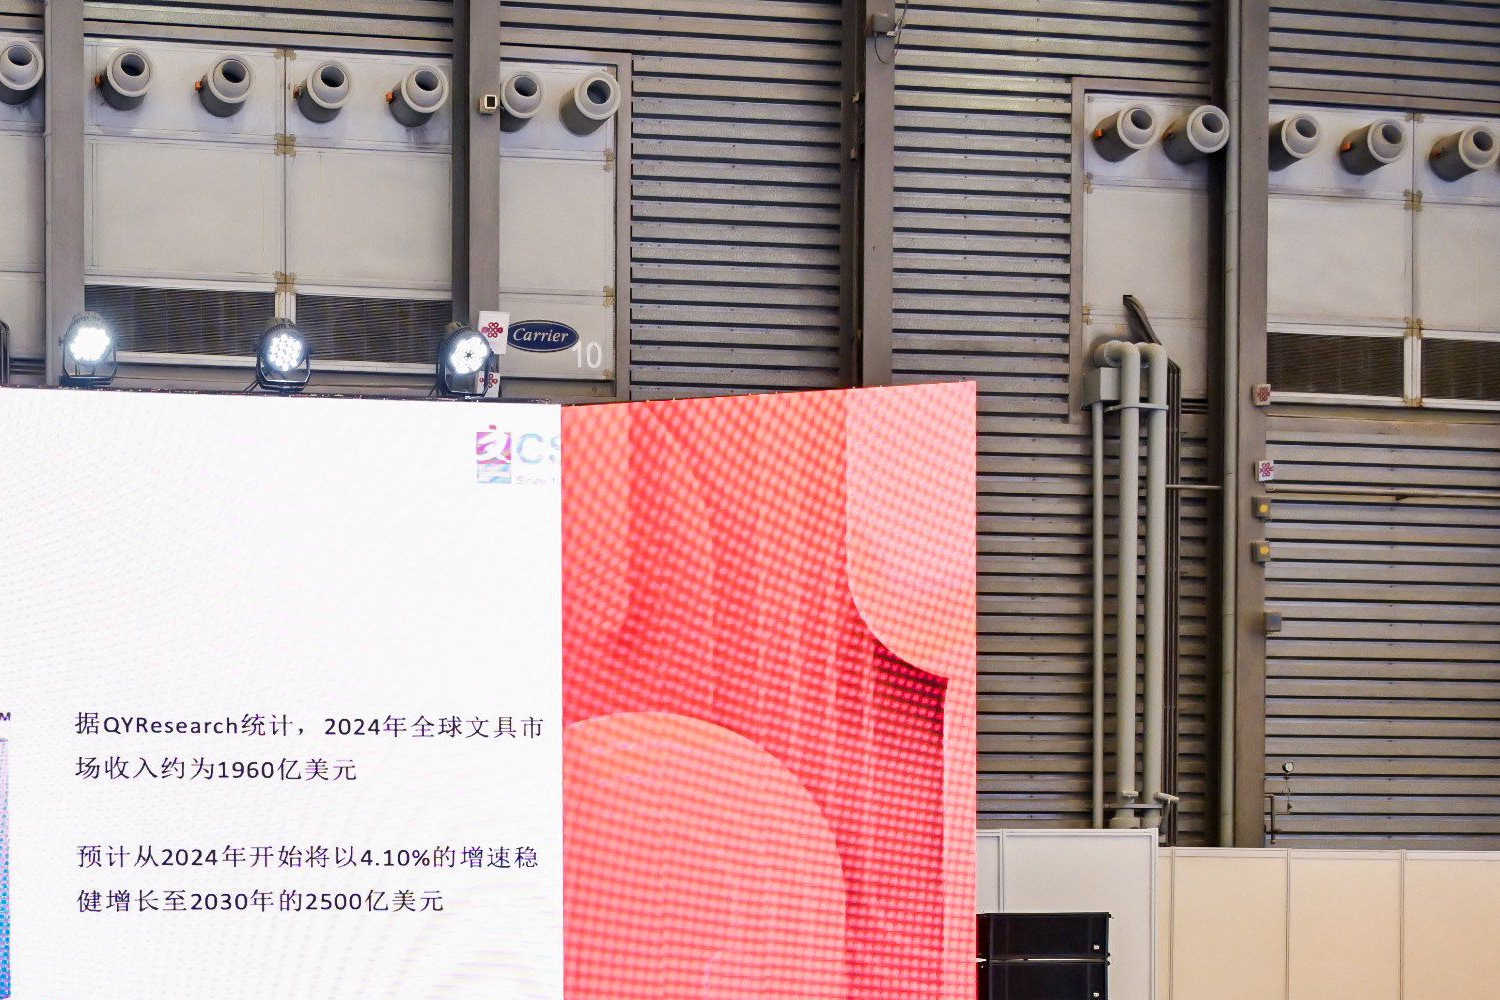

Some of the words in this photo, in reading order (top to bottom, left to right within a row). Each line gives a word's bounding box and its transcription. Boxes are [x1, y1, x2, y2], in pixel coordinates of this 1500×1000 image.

[512, 327, 570, 343] Carrier
[572, 341, 604, 369] 10
[74, 711, 545, 739] 据QYResearch统计，2024年全球文具市
[75, 756, 358, 781] 场收入约为1960亿美元
[76, 845, 538, 869] 预计从2024年开始将以4.10%的增速稳
[77, 889, 445, 913] 健增长至2030年的2500亿美元
